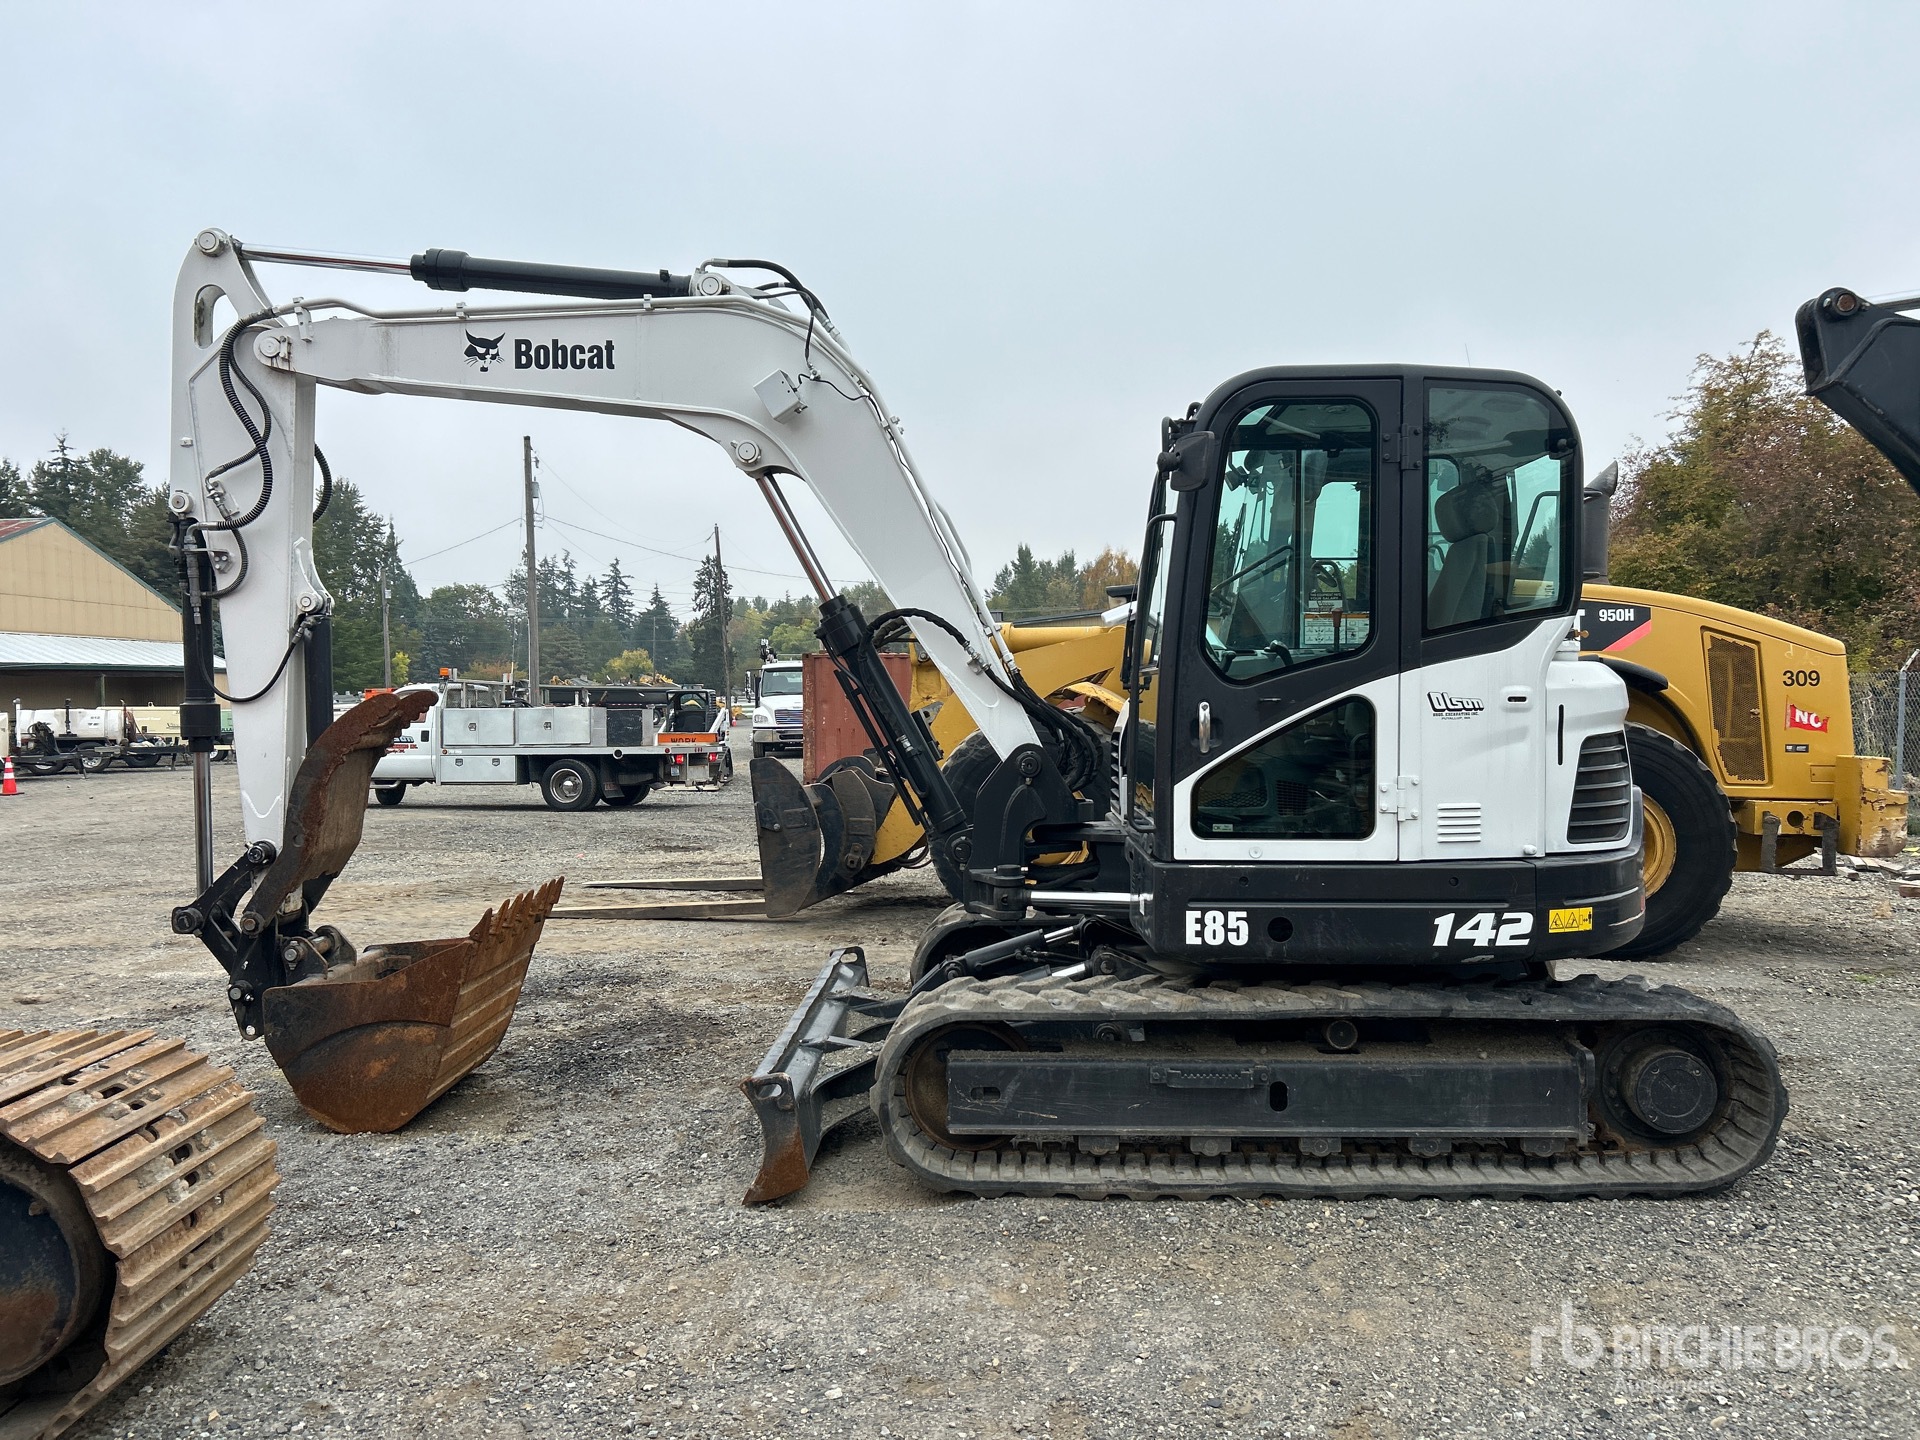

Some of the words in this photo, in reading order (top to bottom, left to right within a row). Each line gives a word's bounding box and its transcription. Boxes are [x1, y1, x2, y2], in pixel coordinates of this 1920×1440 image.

[514, 338, 616, 370] Bobcat
[1598, 608, 1635, 622] 950H
[1782, 669, 1821, 687] 309
[1427, 691, 1485, 712] Olson
[1795, 708, 1822, 728] NC
[1185, 910, 1249, 946] E85
[1432, 911, 1534, 947] 142
